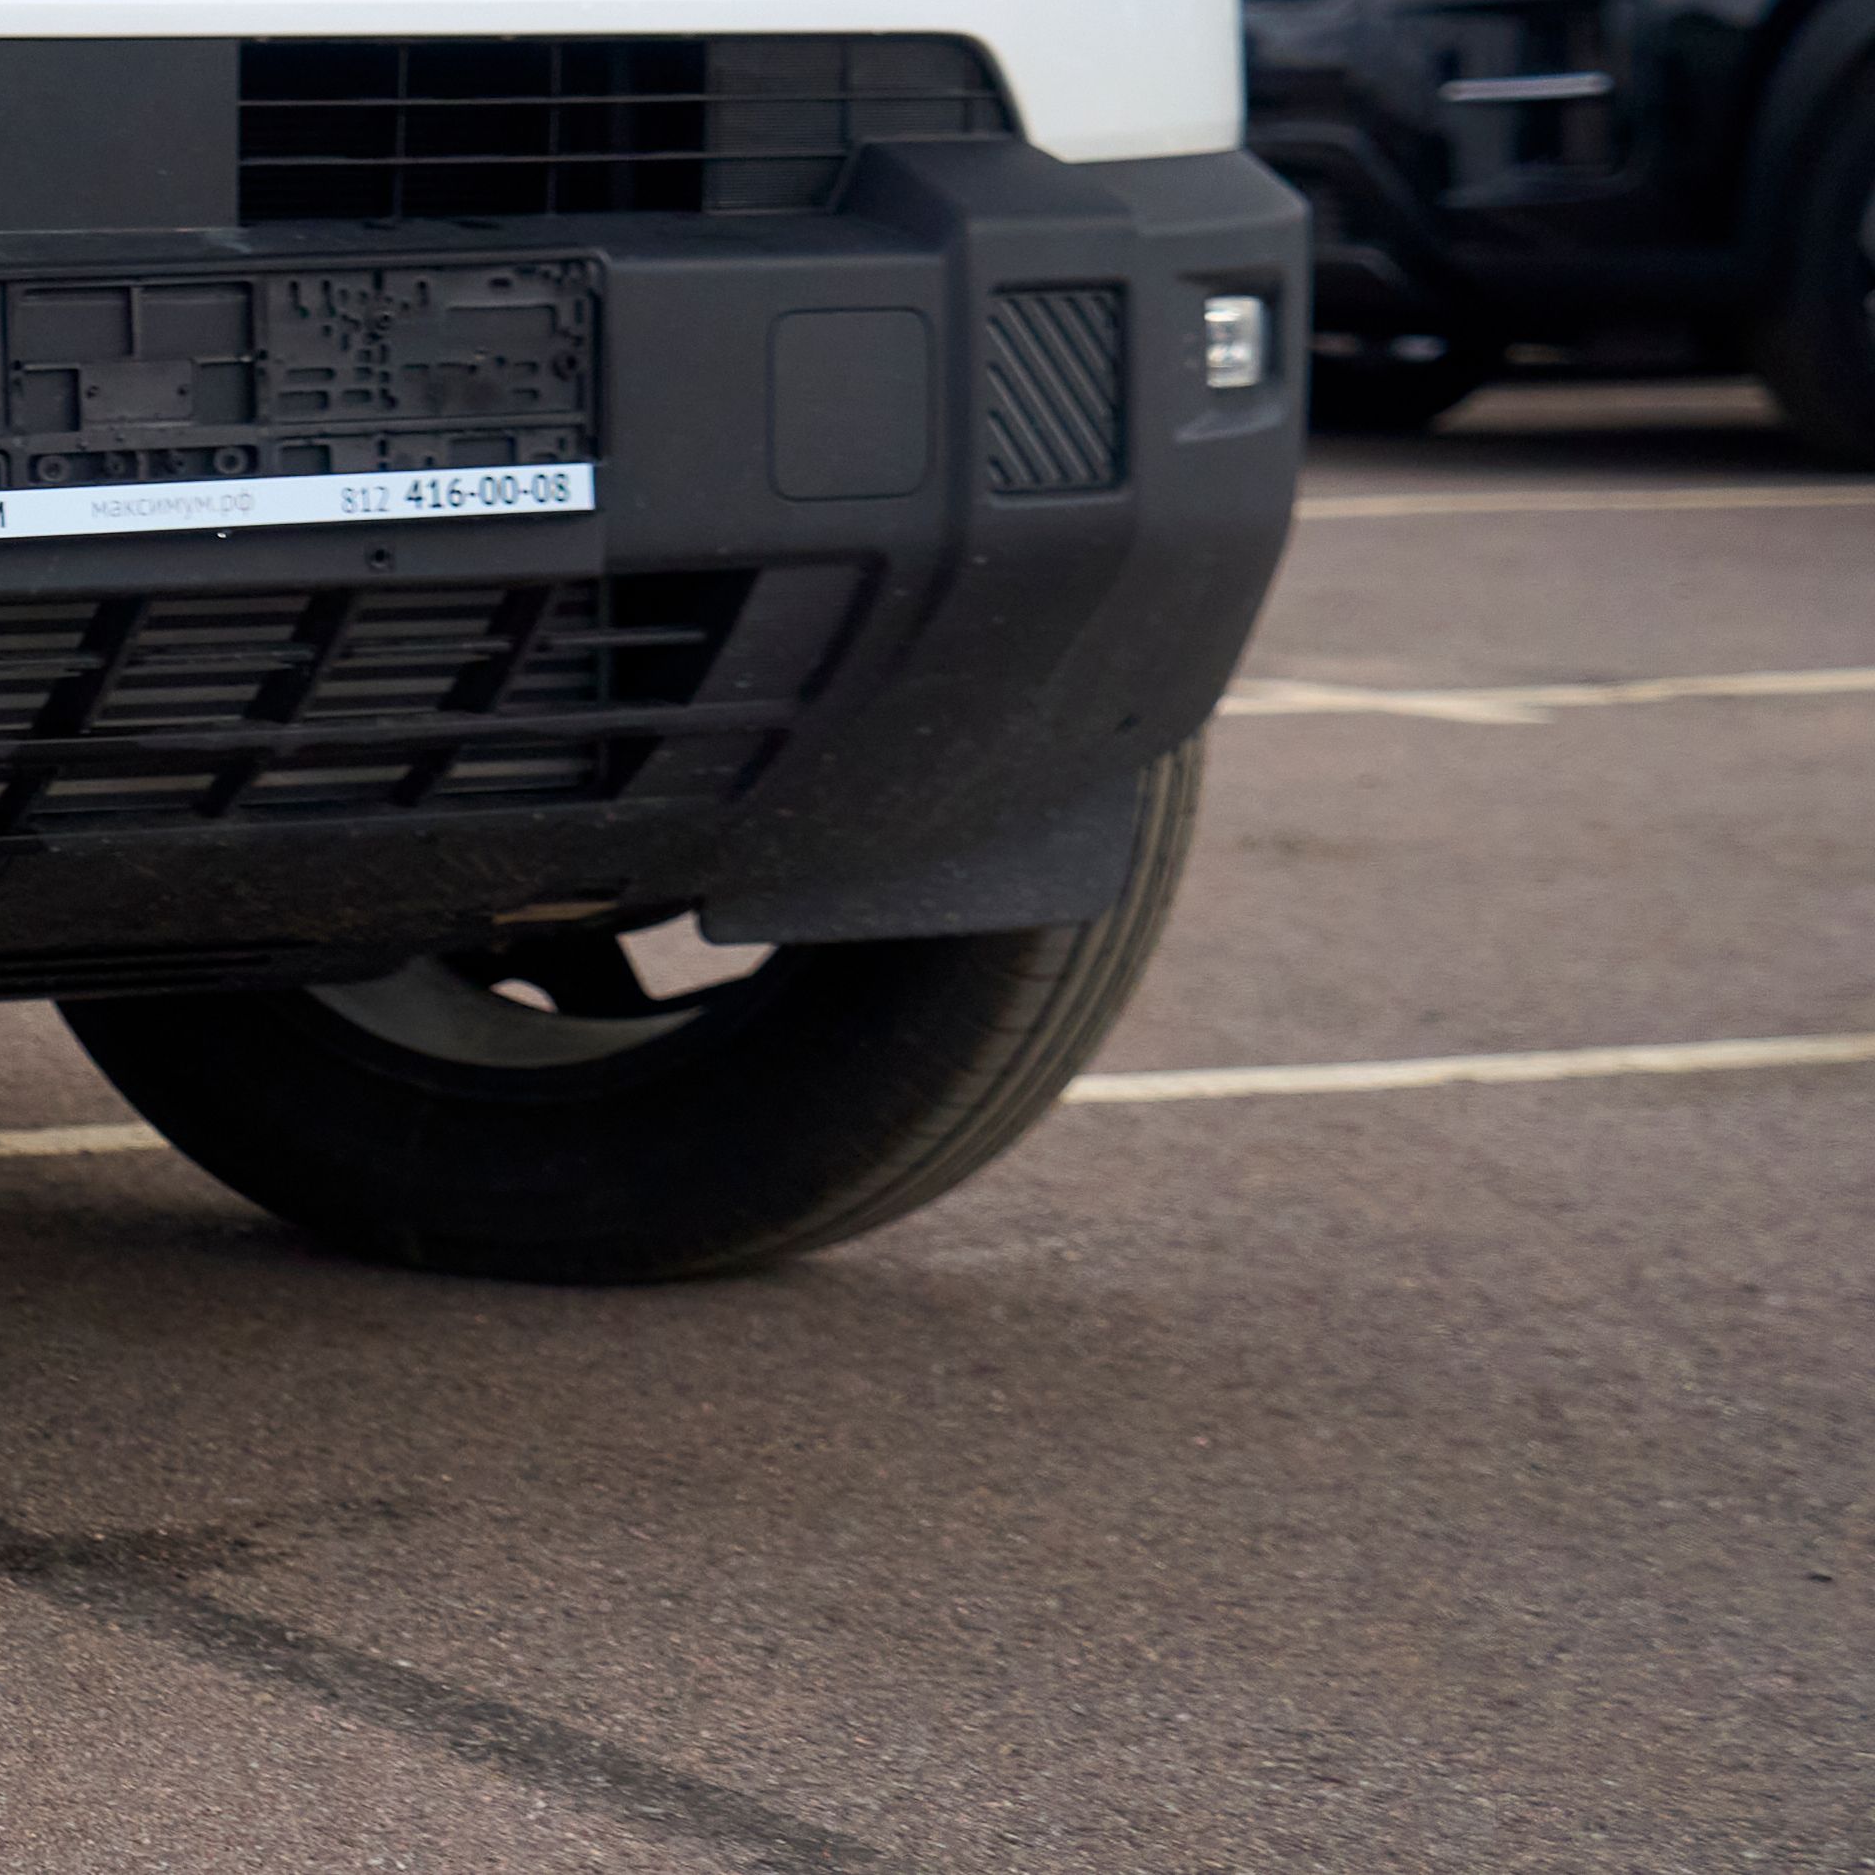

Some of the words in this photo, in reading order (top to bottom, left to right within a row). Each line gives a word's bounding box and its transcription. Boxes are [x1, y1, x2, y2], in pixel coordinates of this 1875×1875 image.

[90, 488, 255, 521] максимум.рф
[340, 486, 390, 515] 812
[404, 472, 572, 509] 416-00-08
